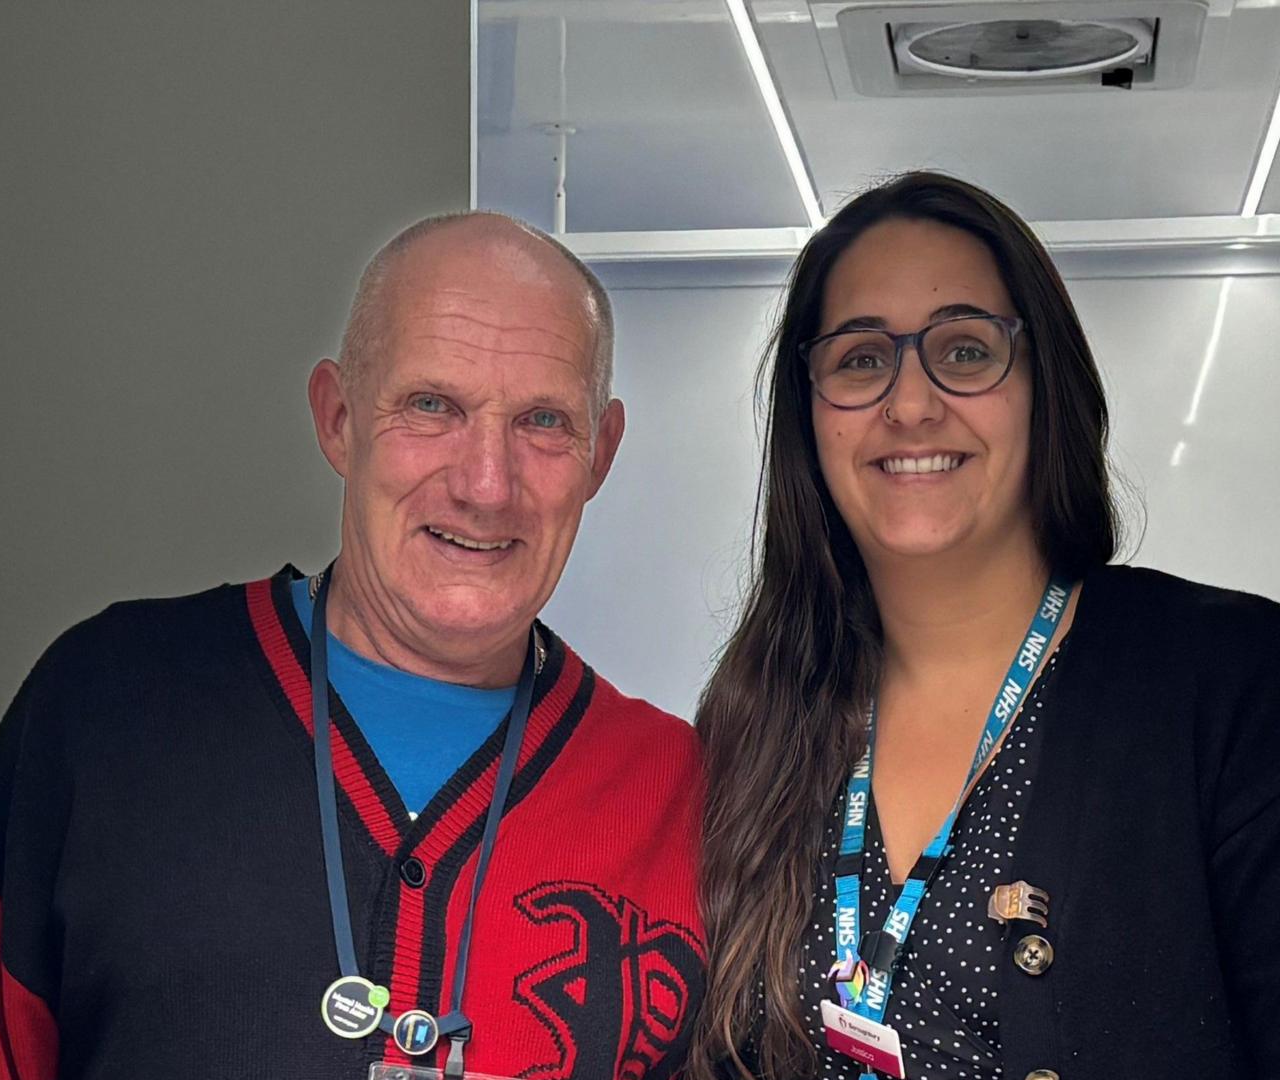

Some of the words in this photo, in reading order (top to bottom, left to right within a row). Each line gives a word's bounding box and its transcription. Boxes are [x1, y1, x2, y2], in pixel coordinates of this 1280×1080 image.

[1040, 585, 1066, 622] NHS
[1019, 631, 1046, 672] NHS
[995, 679, 1022, 723] NHS
[847, 791, 866, 827] NHS
[839, 907, 856, 946] NHS
[884, 909, 910, 943] HS
[867, 967, 889, 1011] NHS
